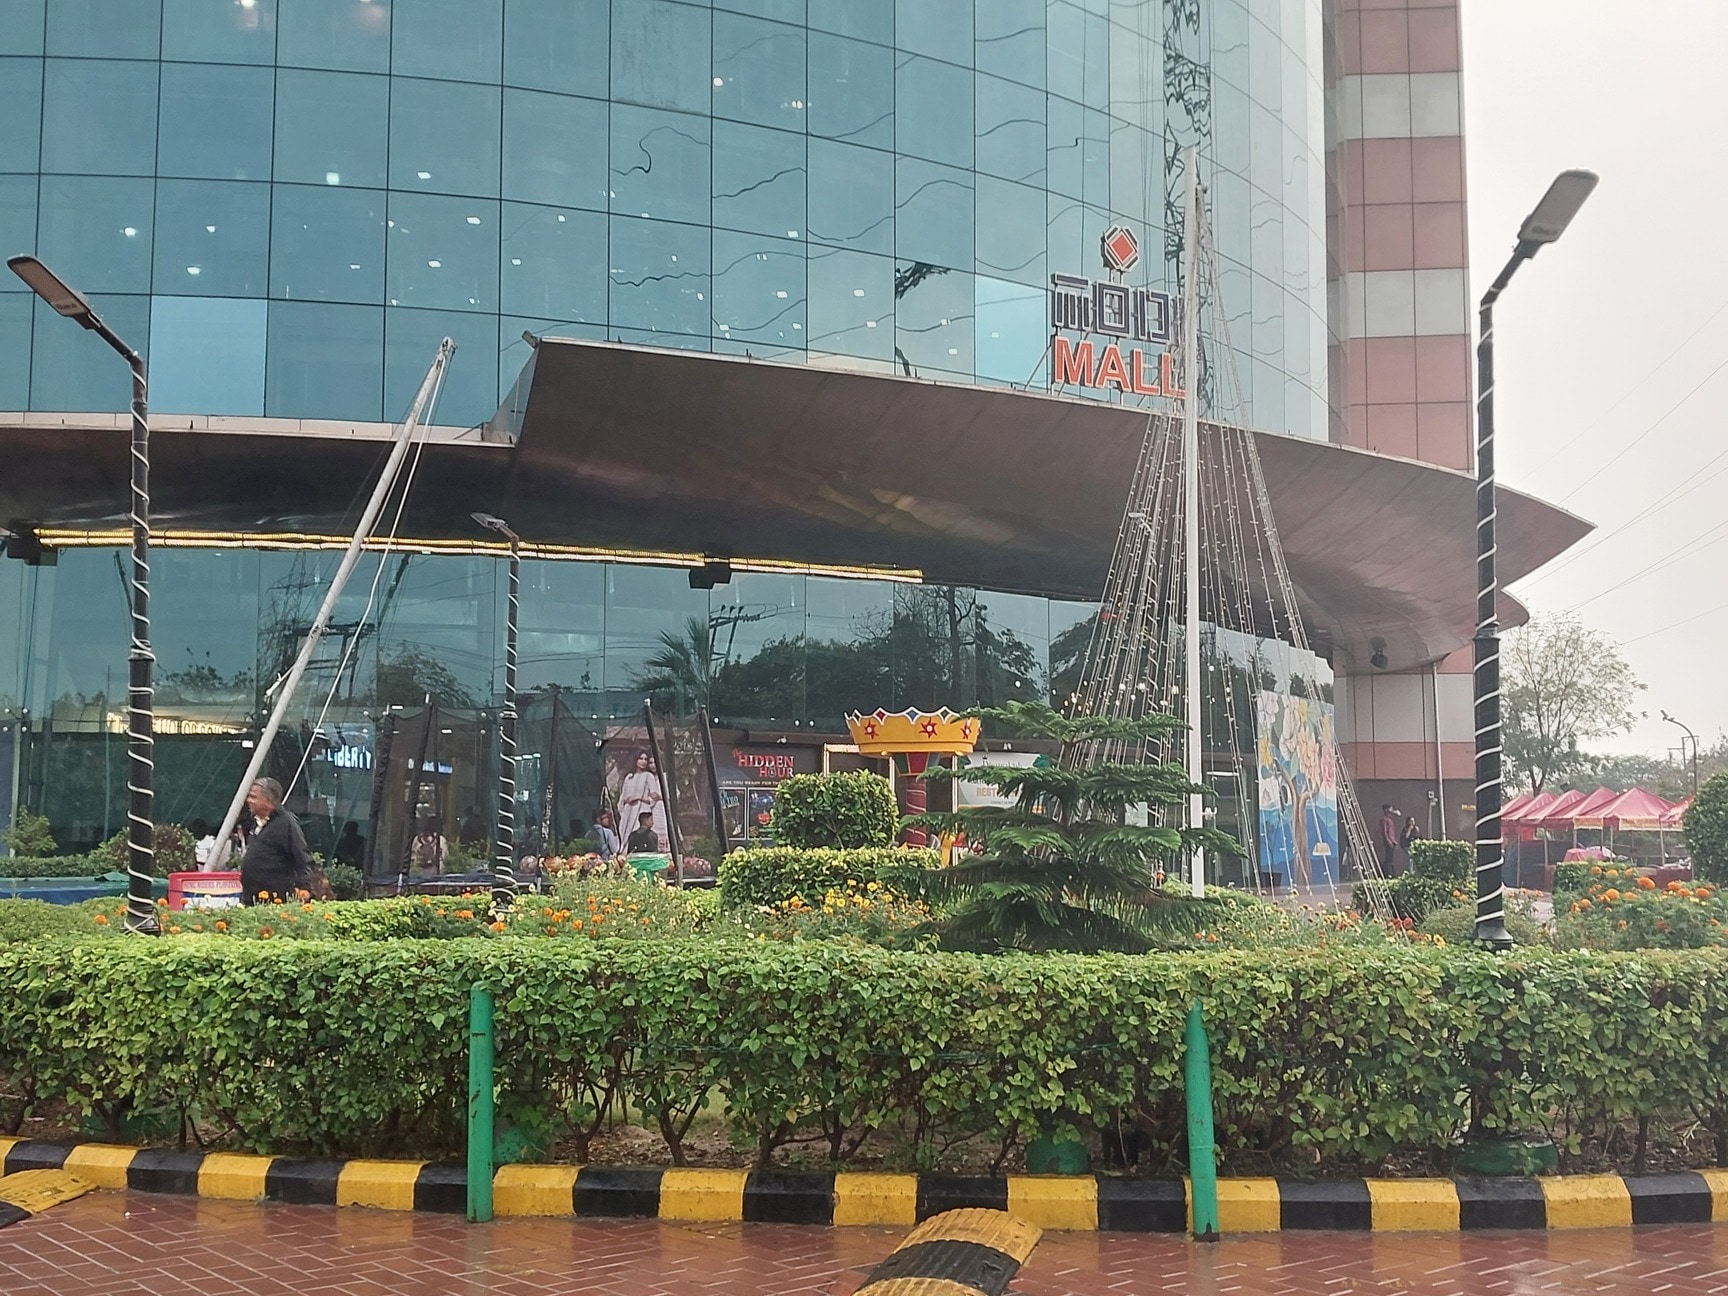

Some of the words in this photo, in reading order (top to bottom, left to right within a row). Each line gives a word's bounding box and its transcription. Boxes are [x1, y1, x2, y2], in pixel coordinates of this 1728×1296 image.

[1050, 335, 1187, 400] MALL
[327, 744, 371, 770] LIBERTY
[738, 755, 794, 768] HIDDEN
[759, 766, 795, 778] HOUR
